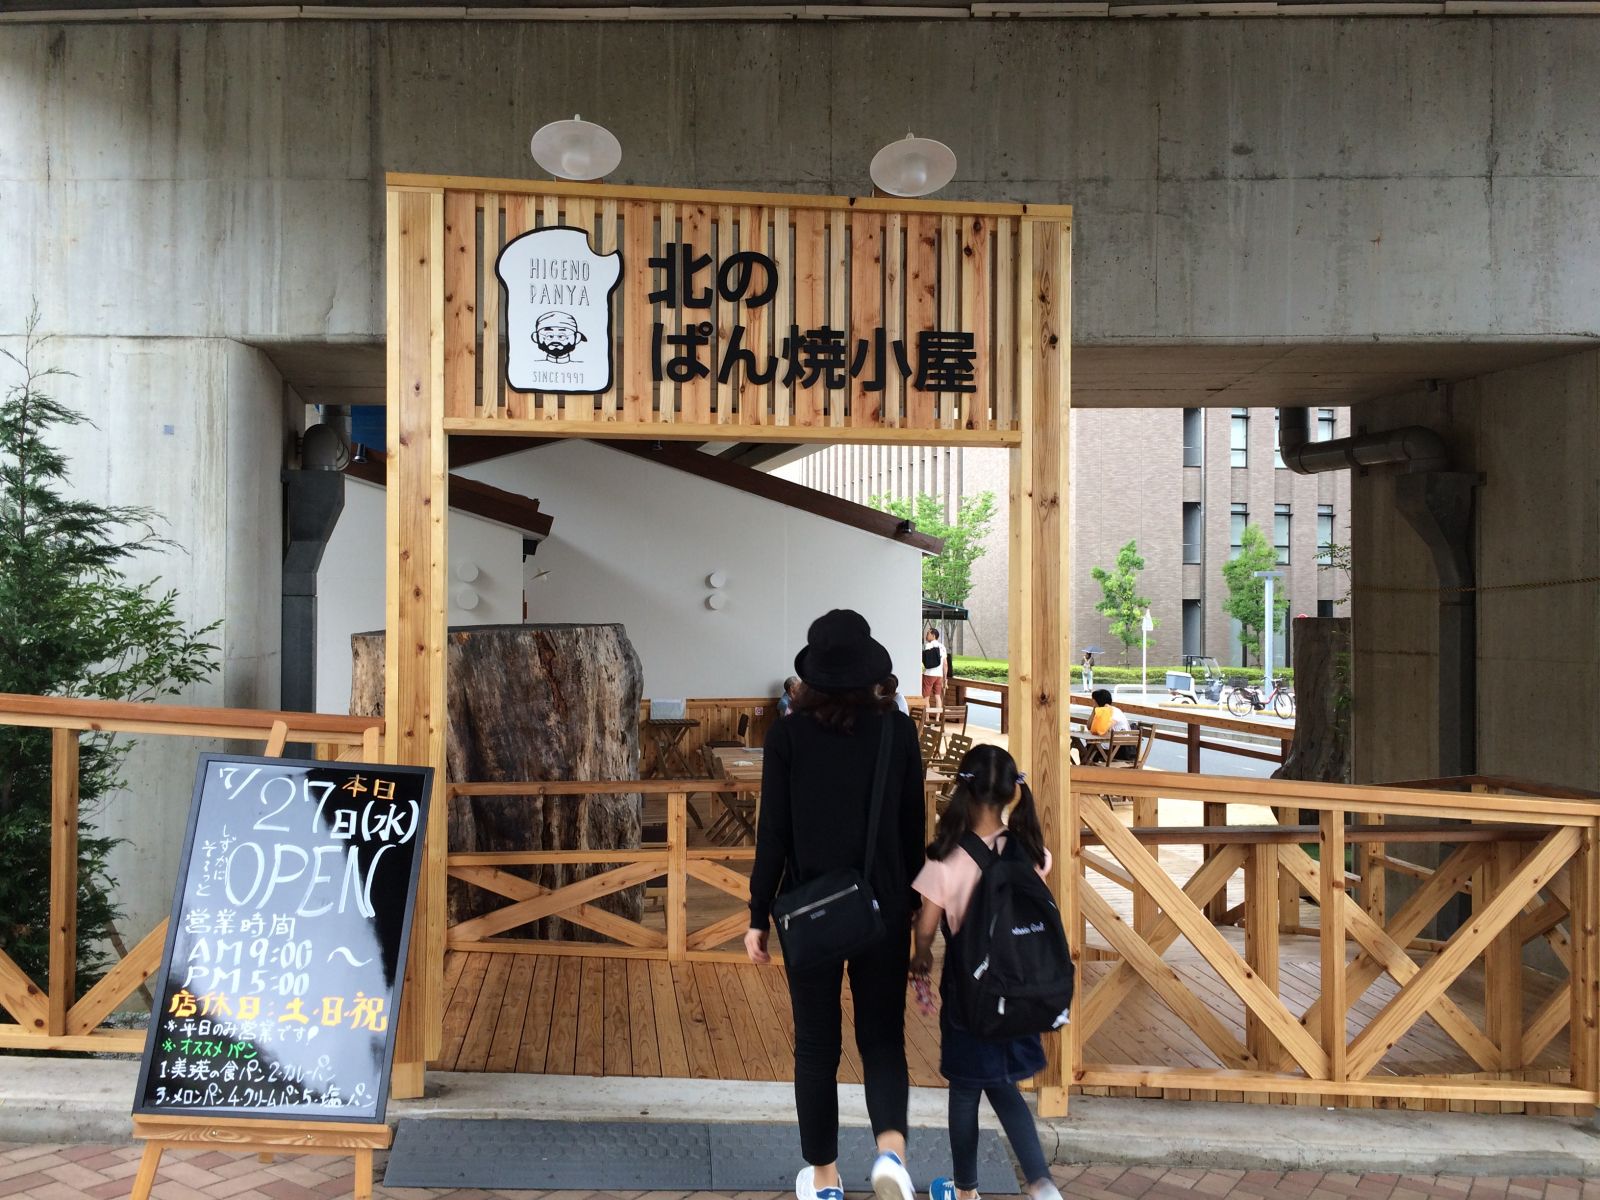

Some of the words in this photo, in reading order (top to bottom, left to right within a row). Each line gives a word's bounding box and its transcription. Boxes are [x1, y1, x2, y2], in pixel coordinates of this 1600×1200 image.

[529, 258, 590, 281] HIGENO
[648, 242, 778, 309] 北の
[530, 283, 590, 306] PANYA
[652, 321, 977, 394] ぱん焼小屋
[342, 774, 396, 800] 本日
[225, 842, 397, 918] OPEN
[185, 908, 296, 941] 営業時間
